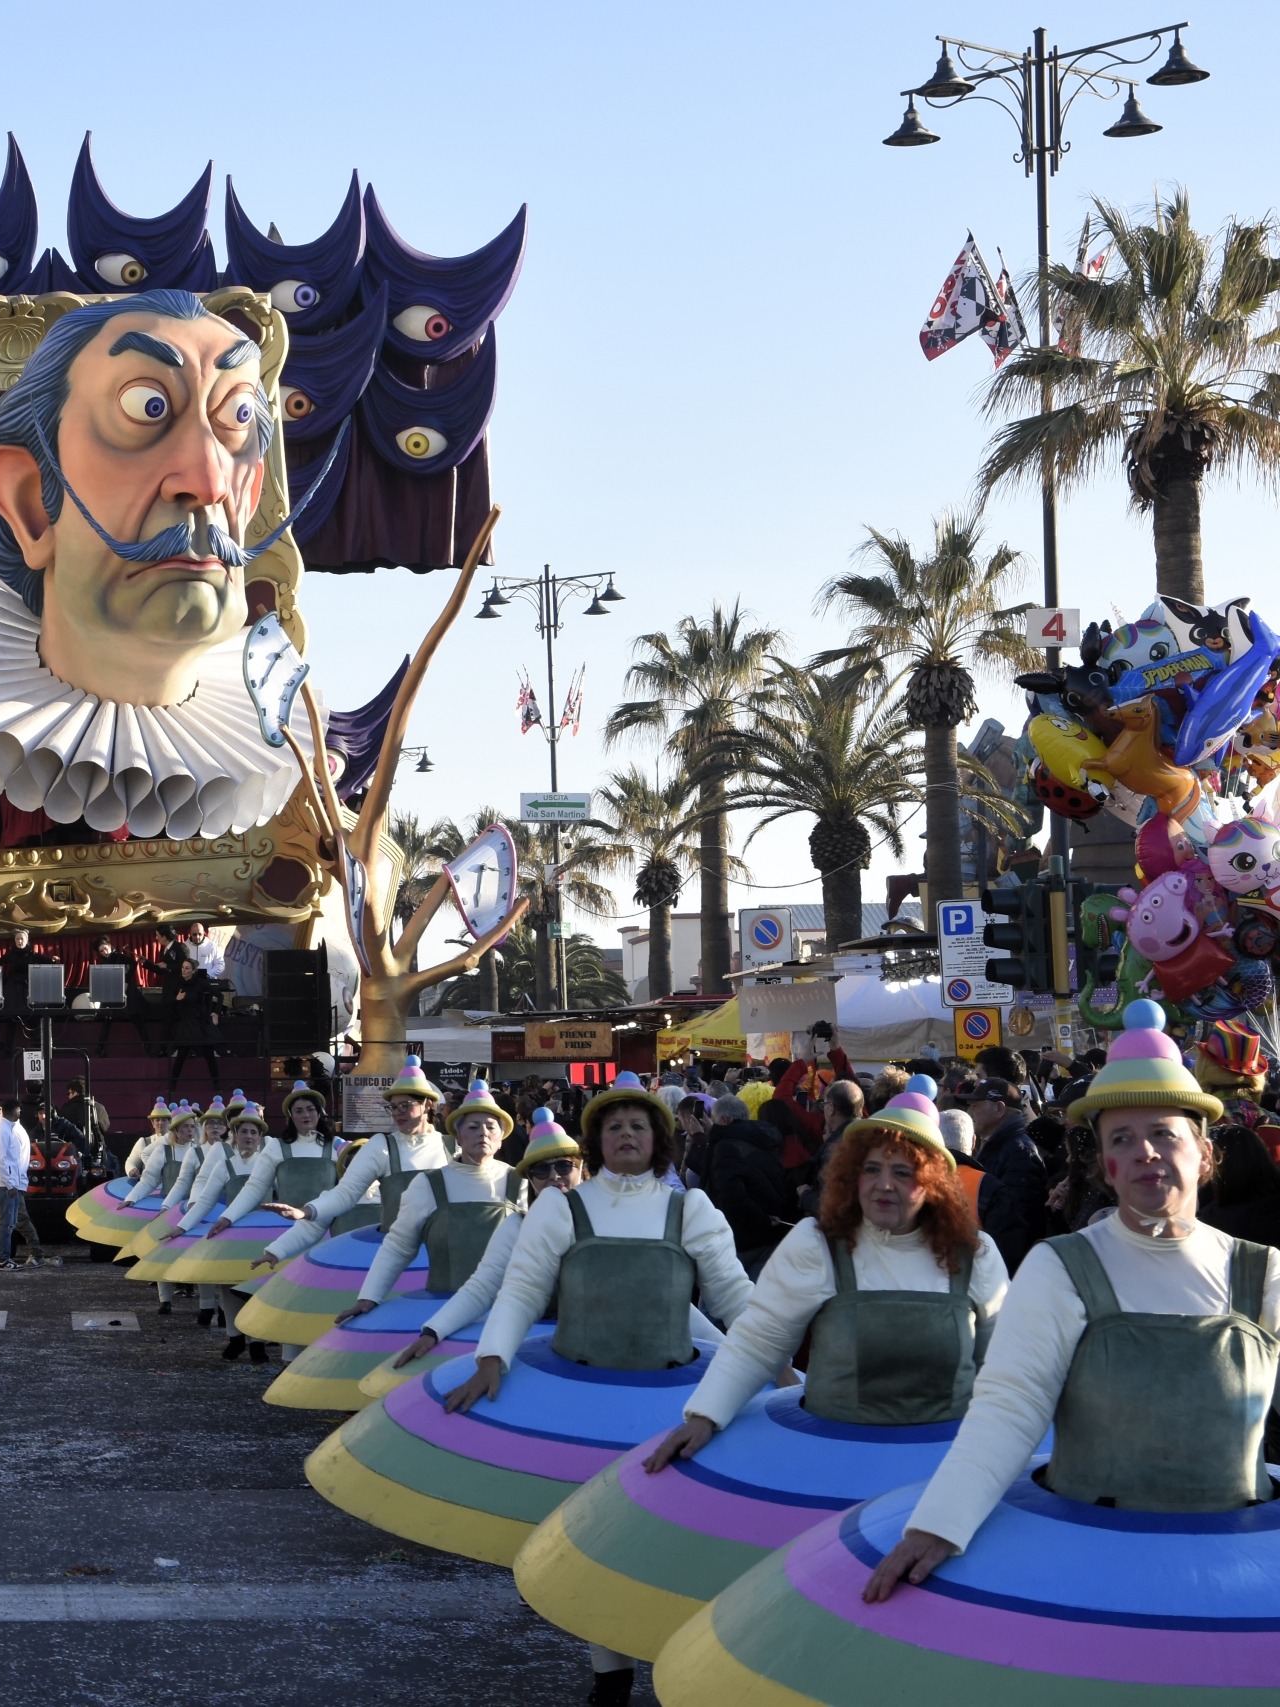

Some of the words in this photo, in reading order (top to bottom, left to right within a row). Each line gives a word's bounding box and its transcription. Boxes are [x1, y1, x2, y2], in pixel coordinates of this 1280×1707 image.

[1042, 613, 1067, 642] 4
[1142, 654, 1214, 690] SPIDER-MAN
[526, 810, 539, 818] Via
[540, 810, 556, 818] San
[558, 810, 586, 819] Martino
[949, 909, 967, 932] P
[224, 936, 264, 970] DEST
[560, 1030, 597, 1039] FRENCH
[564, 1040, 592, 1049] FRIES
[31, 1059, 42, 1072] 03
[345, 1077, 352, 1086] IL
[354, 1077, 379, 1087] CIRCO
